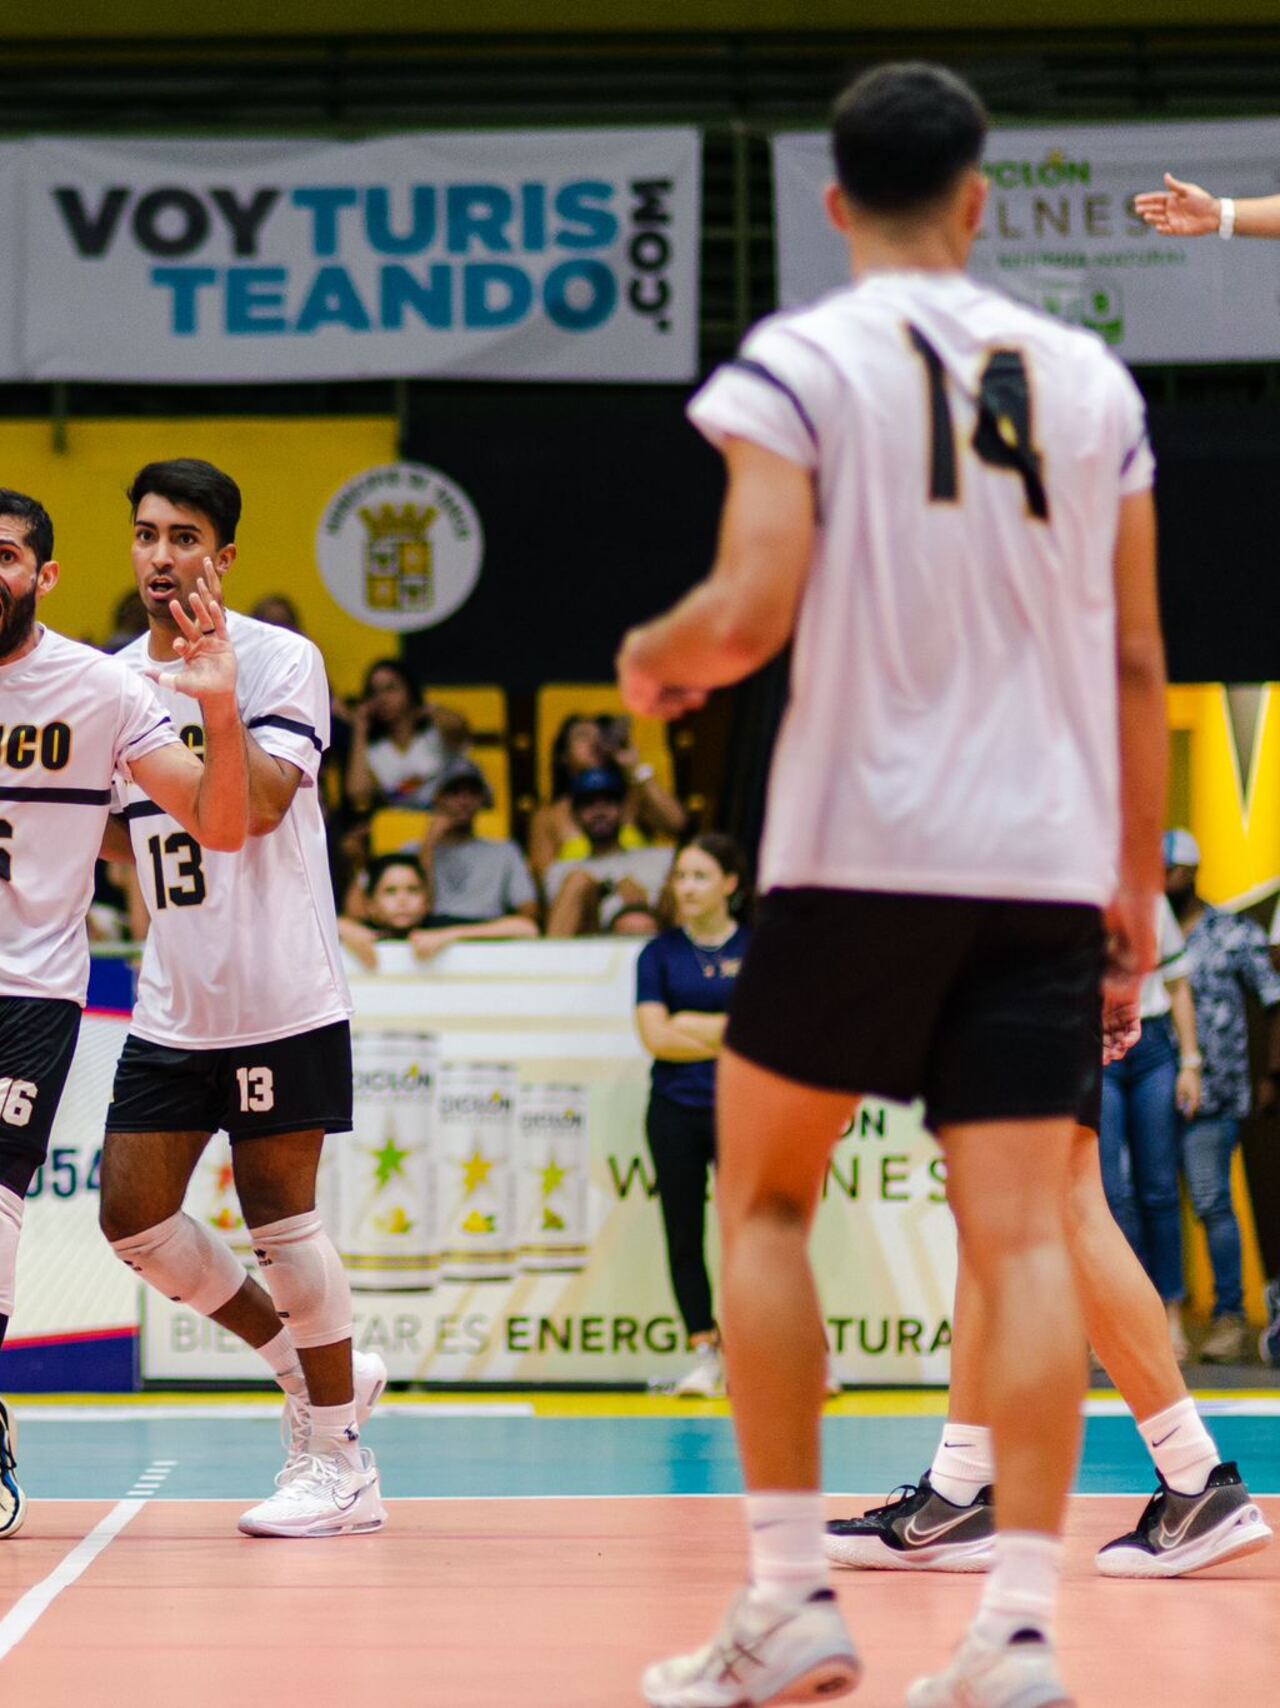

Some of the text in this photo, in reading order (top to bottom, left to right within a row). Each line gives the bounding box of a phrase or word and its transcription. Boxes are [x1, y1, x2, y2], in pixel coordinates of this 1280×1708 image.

[150, 259, 617, 335] TEANDO
[901, 320, 1051, 524] 14
[147, 830, 207, 911] 13
[236, 1066, 274, 1113] 13
[435, 1312, 490, 1354] ES
[507, 1316, 695, 1354] ENERG
[827, 1316, 951, 1355] TURA
